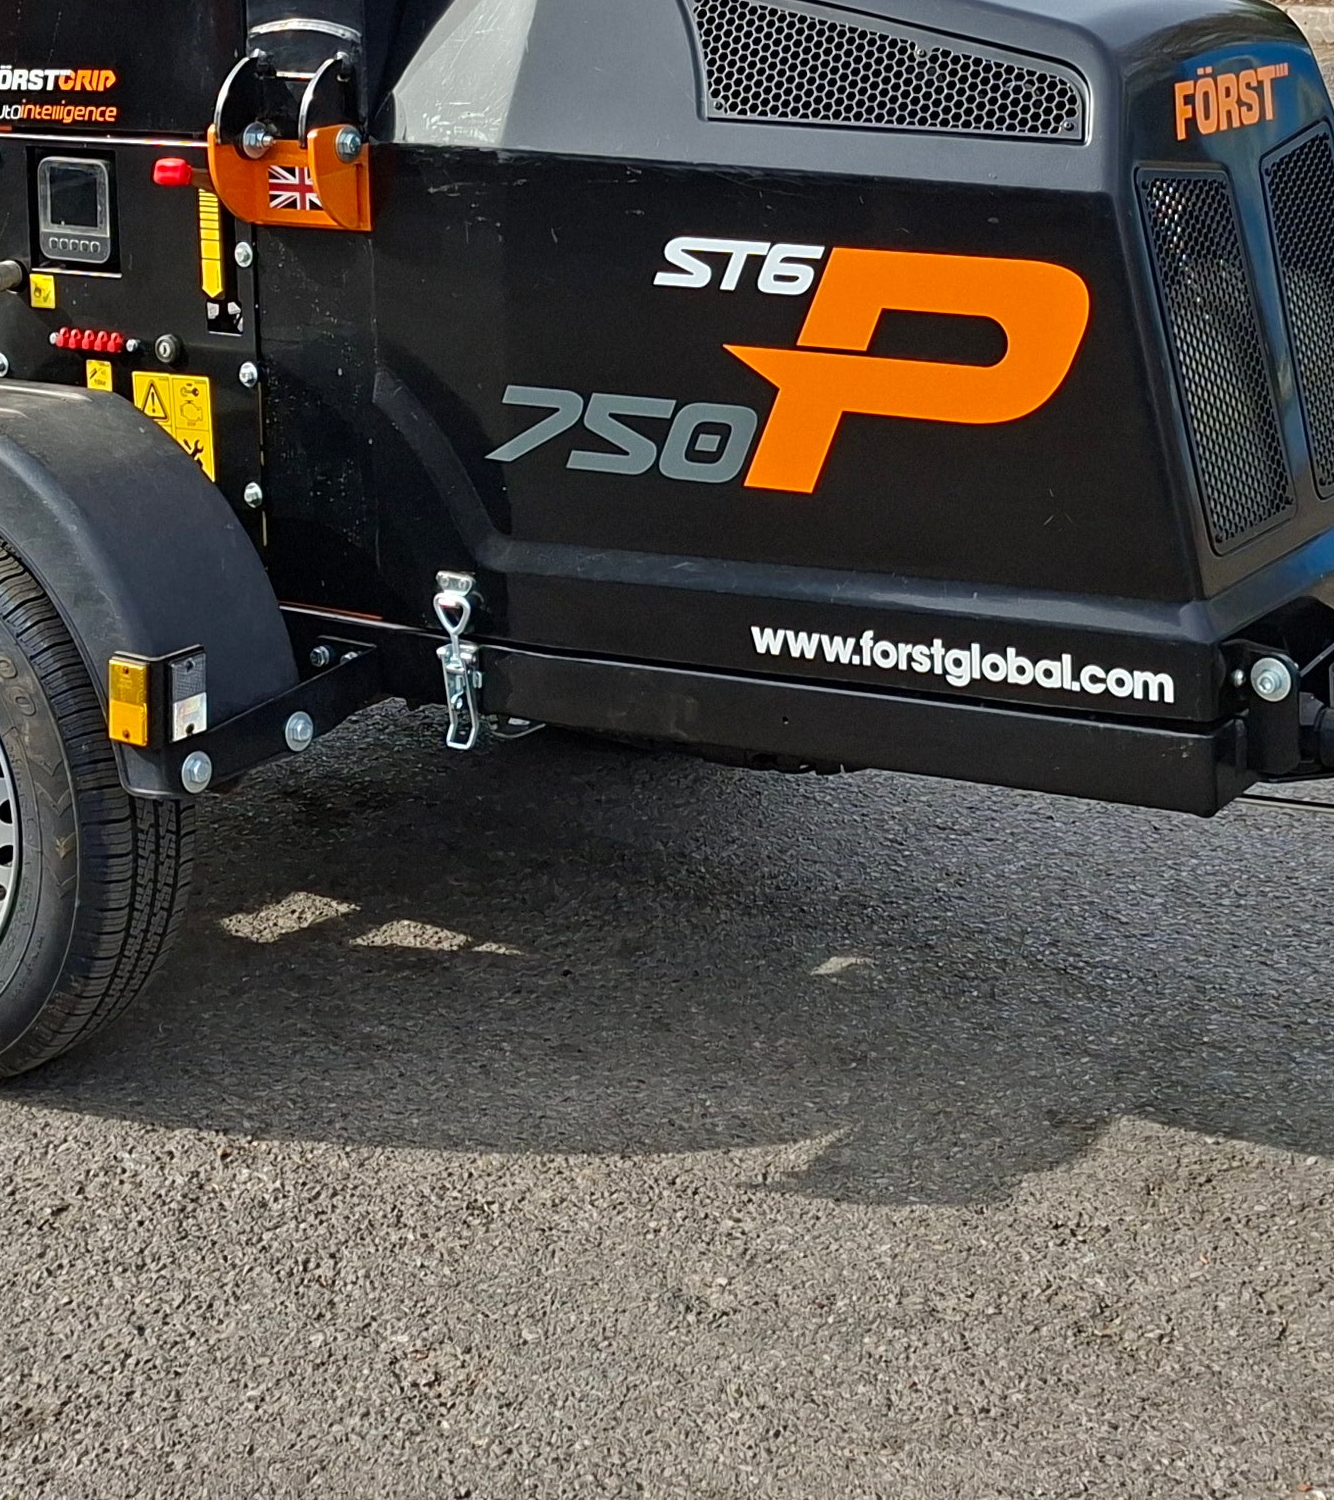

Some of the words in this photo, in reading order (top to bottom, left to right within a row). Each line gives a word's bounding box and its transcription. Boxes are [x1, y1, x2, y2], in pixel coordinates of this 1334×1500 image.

[1174, 62, 1288, 141] FÖRST
[484, 384, 759, 484] 750
[750, 625, 1175, 703] www.forstglobal.com
